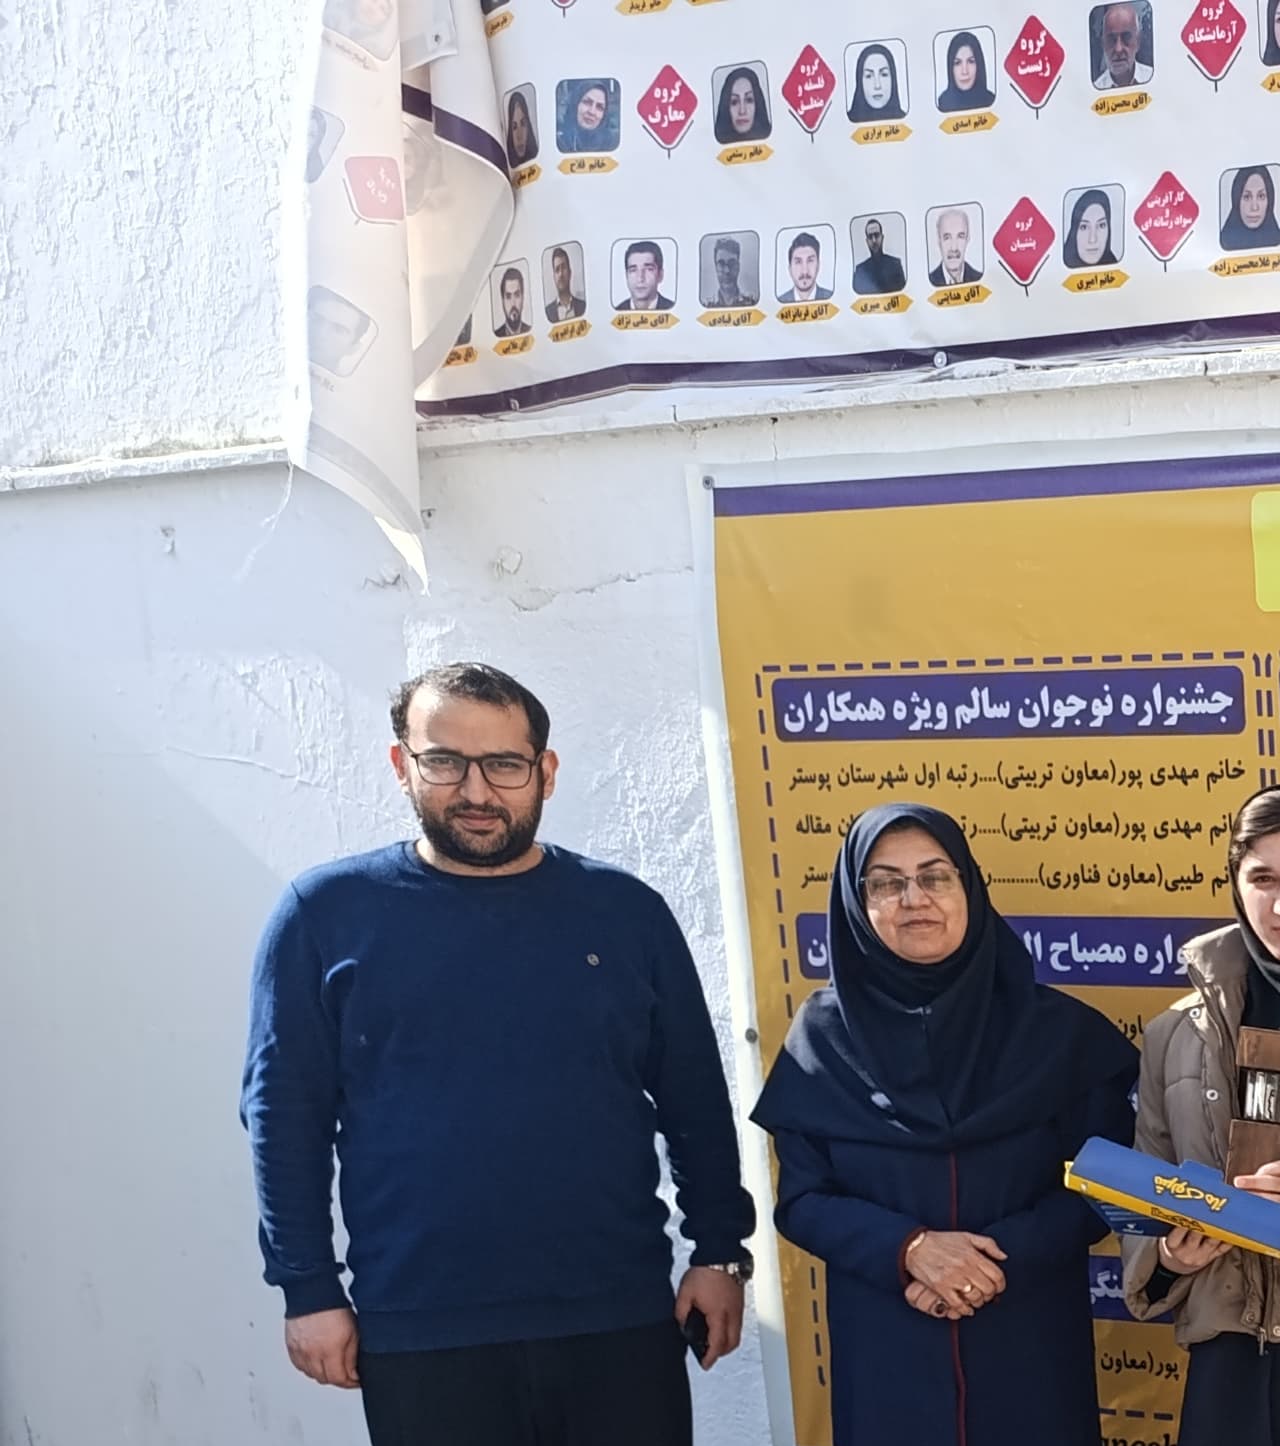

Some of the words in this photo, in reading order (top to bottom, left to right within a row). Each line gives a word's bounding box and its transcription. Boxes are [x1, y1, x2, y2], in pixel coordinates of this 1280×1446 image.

[1202, 2, 1224, 20] گروه
[1021, 30, 1046, 55] گروه
[1189, 20, 1237, 45] آزمایشگاه
[801, 58, 820, 77] گروه
[1018, 56, 1050, 77] زیست
[654, 80, 683, 105] گروه
[804, 78, 825, 92] فلسفه
[1132, 93, 1149, 107] آقای
[648, 104, 686, 129] معارف
[971, 116, 989, 131] خانم
[885, 125, 901, 138] خانم
[749, 147, 763, 160] خانم
[588, 159, 606, 172] خانم
[1015, 217, 1034, 232] گروه
[1213, 260, 1232, 275] زاده
[1101, 273, 1116, 285] خانم
[885, 296, 900, 311] آقای
[963, 287, 980, 301] آقای
[650, 315, 670, 328] آقای
[732, 311, 753, 327] آقای
[811, 305, 829, 319] آقای
[783, 690, 887, 734] همکاران
[891, 691, 949, 733] ویژه
[955, 686, 1010, 731] سالم
[1017, 682, 1114, 729] نوجوان
[1120, 679, 1235, 726] جشنواره
[788, 767, 831, 793] پوستر
[837, 762, 909, 791] شهرستان
[914, 761, 941, 790] اول
[946, 763, 979, 789] رتبه
[1150, 763, 1200, 787] مهدی
[1205, 758, 1246, 793] خانم
[795, 813, 832, 835] مقاله
[1153, 816, 1203, 841] مهدی
[1050, 930, 1127, 973] مصباح
